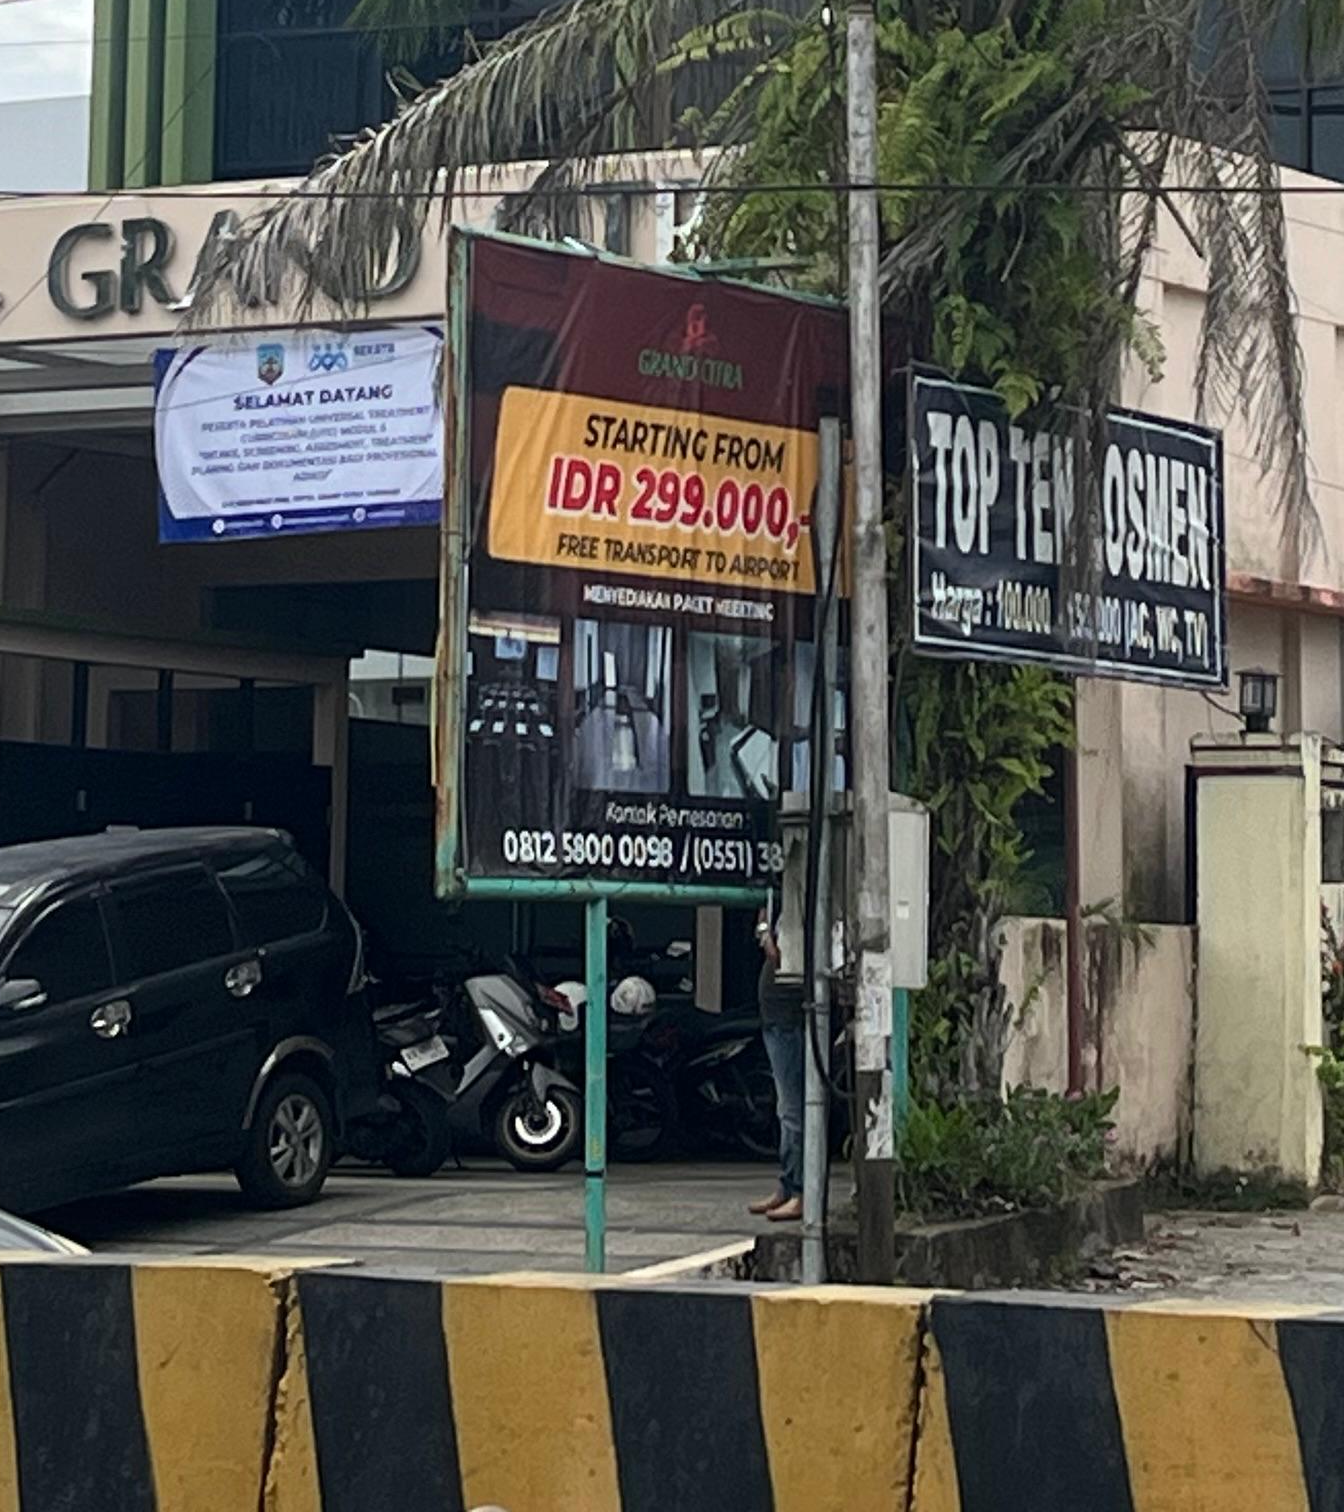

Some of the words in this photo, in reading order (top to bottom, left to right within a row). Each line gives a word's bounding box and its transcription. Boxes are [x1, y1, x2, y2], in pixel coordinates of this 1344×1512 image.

[47, 206, 422, 321] GRAD
[638, 348, 698, 382] GRAND
[233, 390, 316, 411] SELAMAT
[319, 384, 394, 405] DATANG
[583, 413, 708, 463] STARTING
[712, 436, 786, 474] FROM
[547, 456, 623, 517] IDR
[926, 410, 1000, 555] TOP
[1103, 443, 1210, 591] OSMEN
[556, 532, 599, 558] FREE
[603, 537, 702, 569] TRANSPORT
[706, 550, 727, 574] TO
[729, 553, 801, 582] AIRPORT
[606, 801, 656, 824] Kontak
[504, 830, 557, 863] 0812
[561, 832, 614, 866] 5800
[618, 834, 673, 868] 0098
